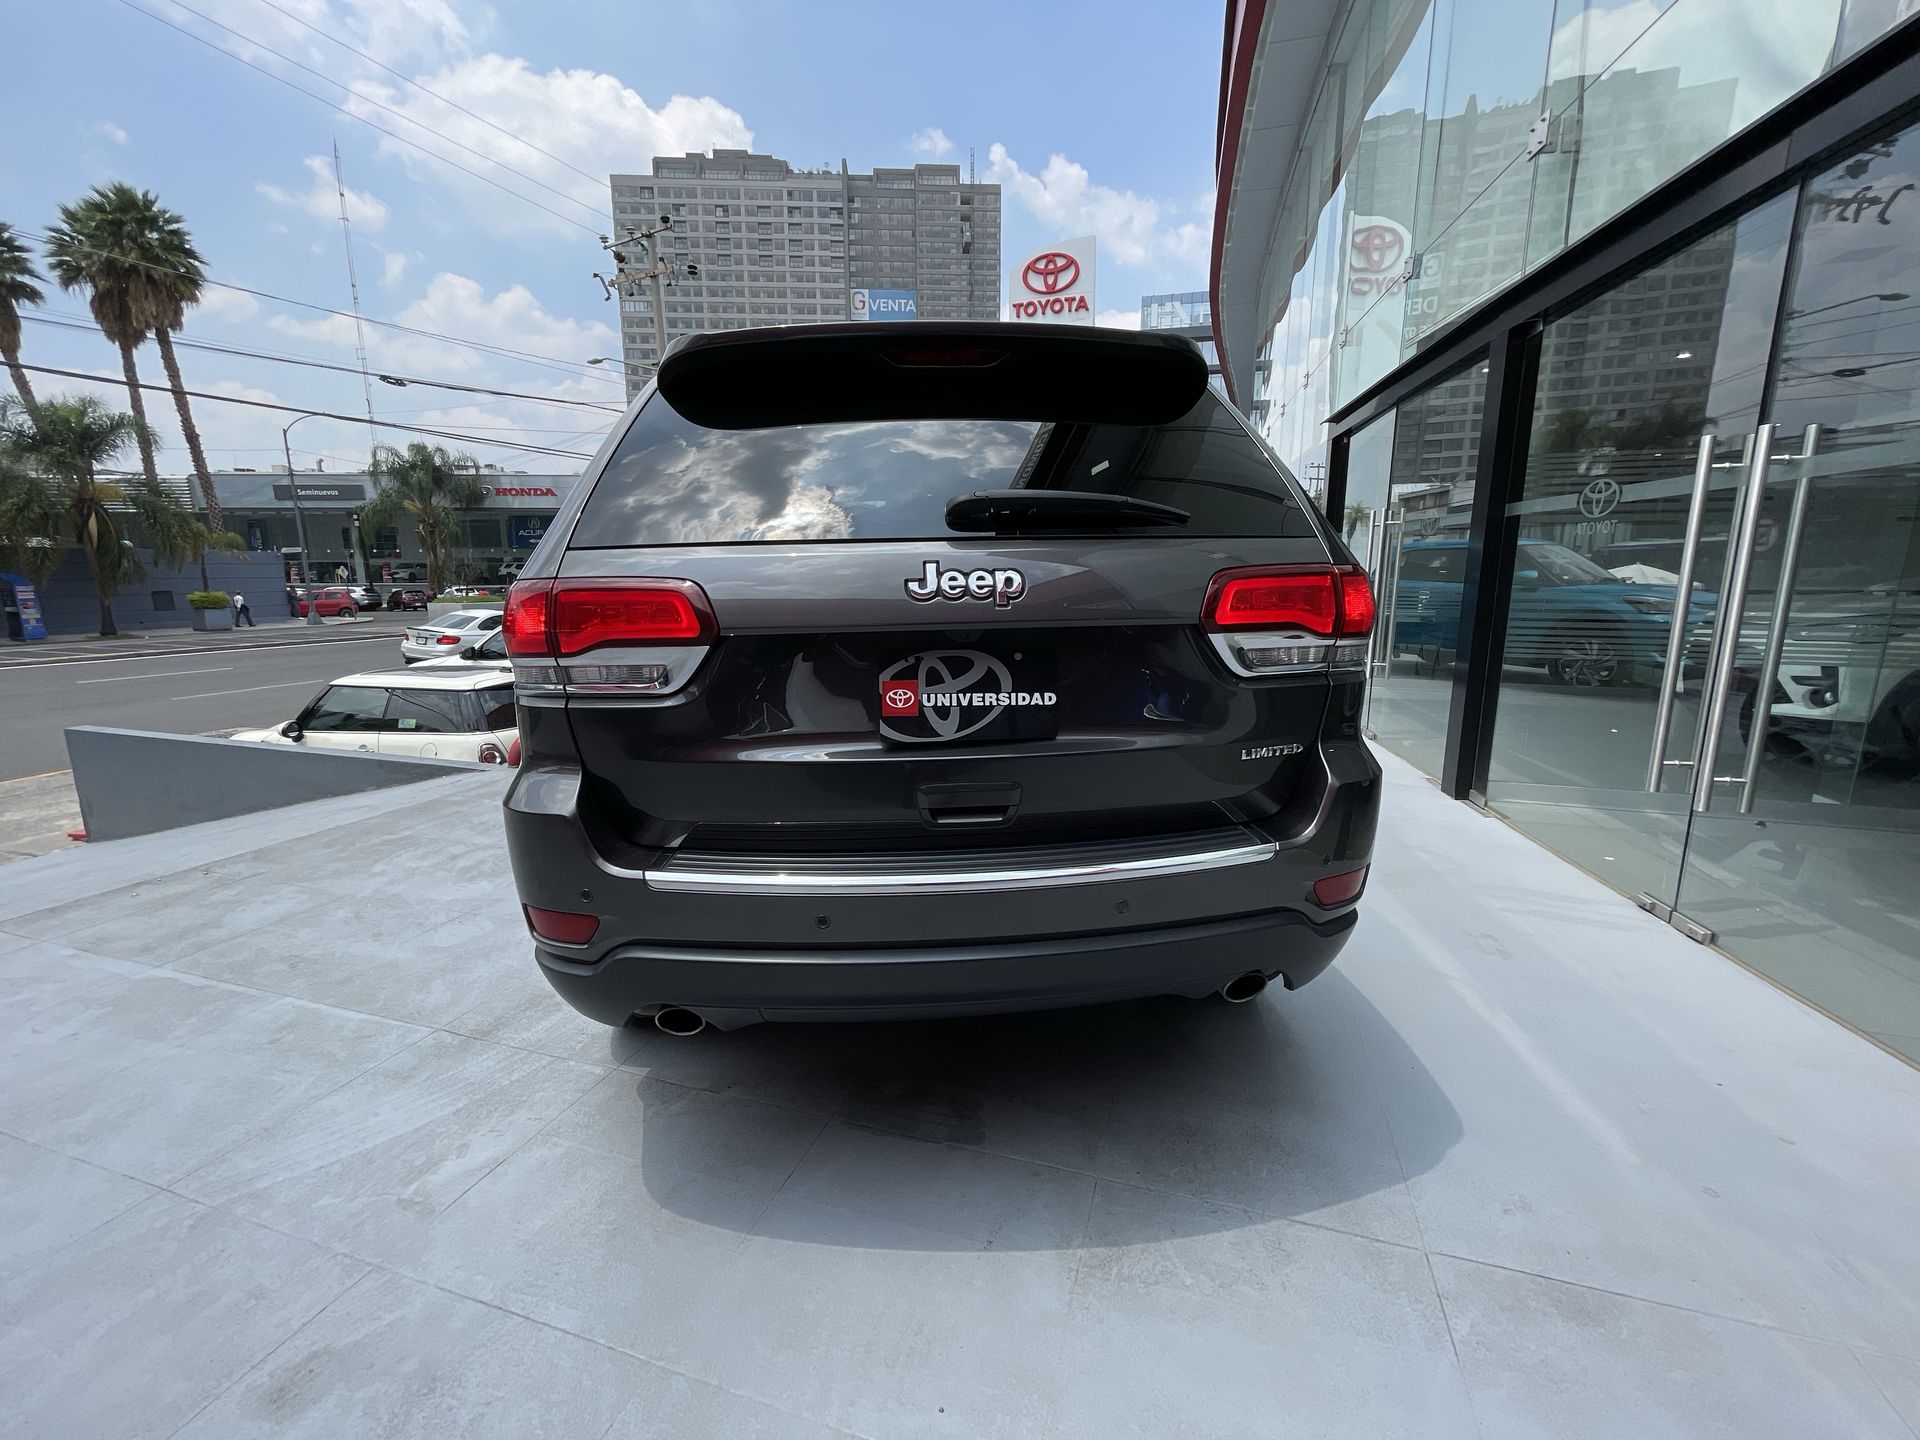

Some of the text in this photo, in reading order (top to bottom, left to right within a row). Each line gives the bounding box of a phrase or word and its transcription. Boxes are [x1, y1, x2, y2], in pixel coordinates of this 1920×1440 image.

[869, 299, 916, 313] VENTA
[1012, 295, 1089, 319] TOYOTA
[297, 488, 339, 496] Seminuevos
[494, 487, 558, 497] HONDA
[905, 560, 1027, 609] Jeep
[921, 691, 1057, 708] UNIVERSIDAD
[1240, 742, 1304, 761] LIMITED
